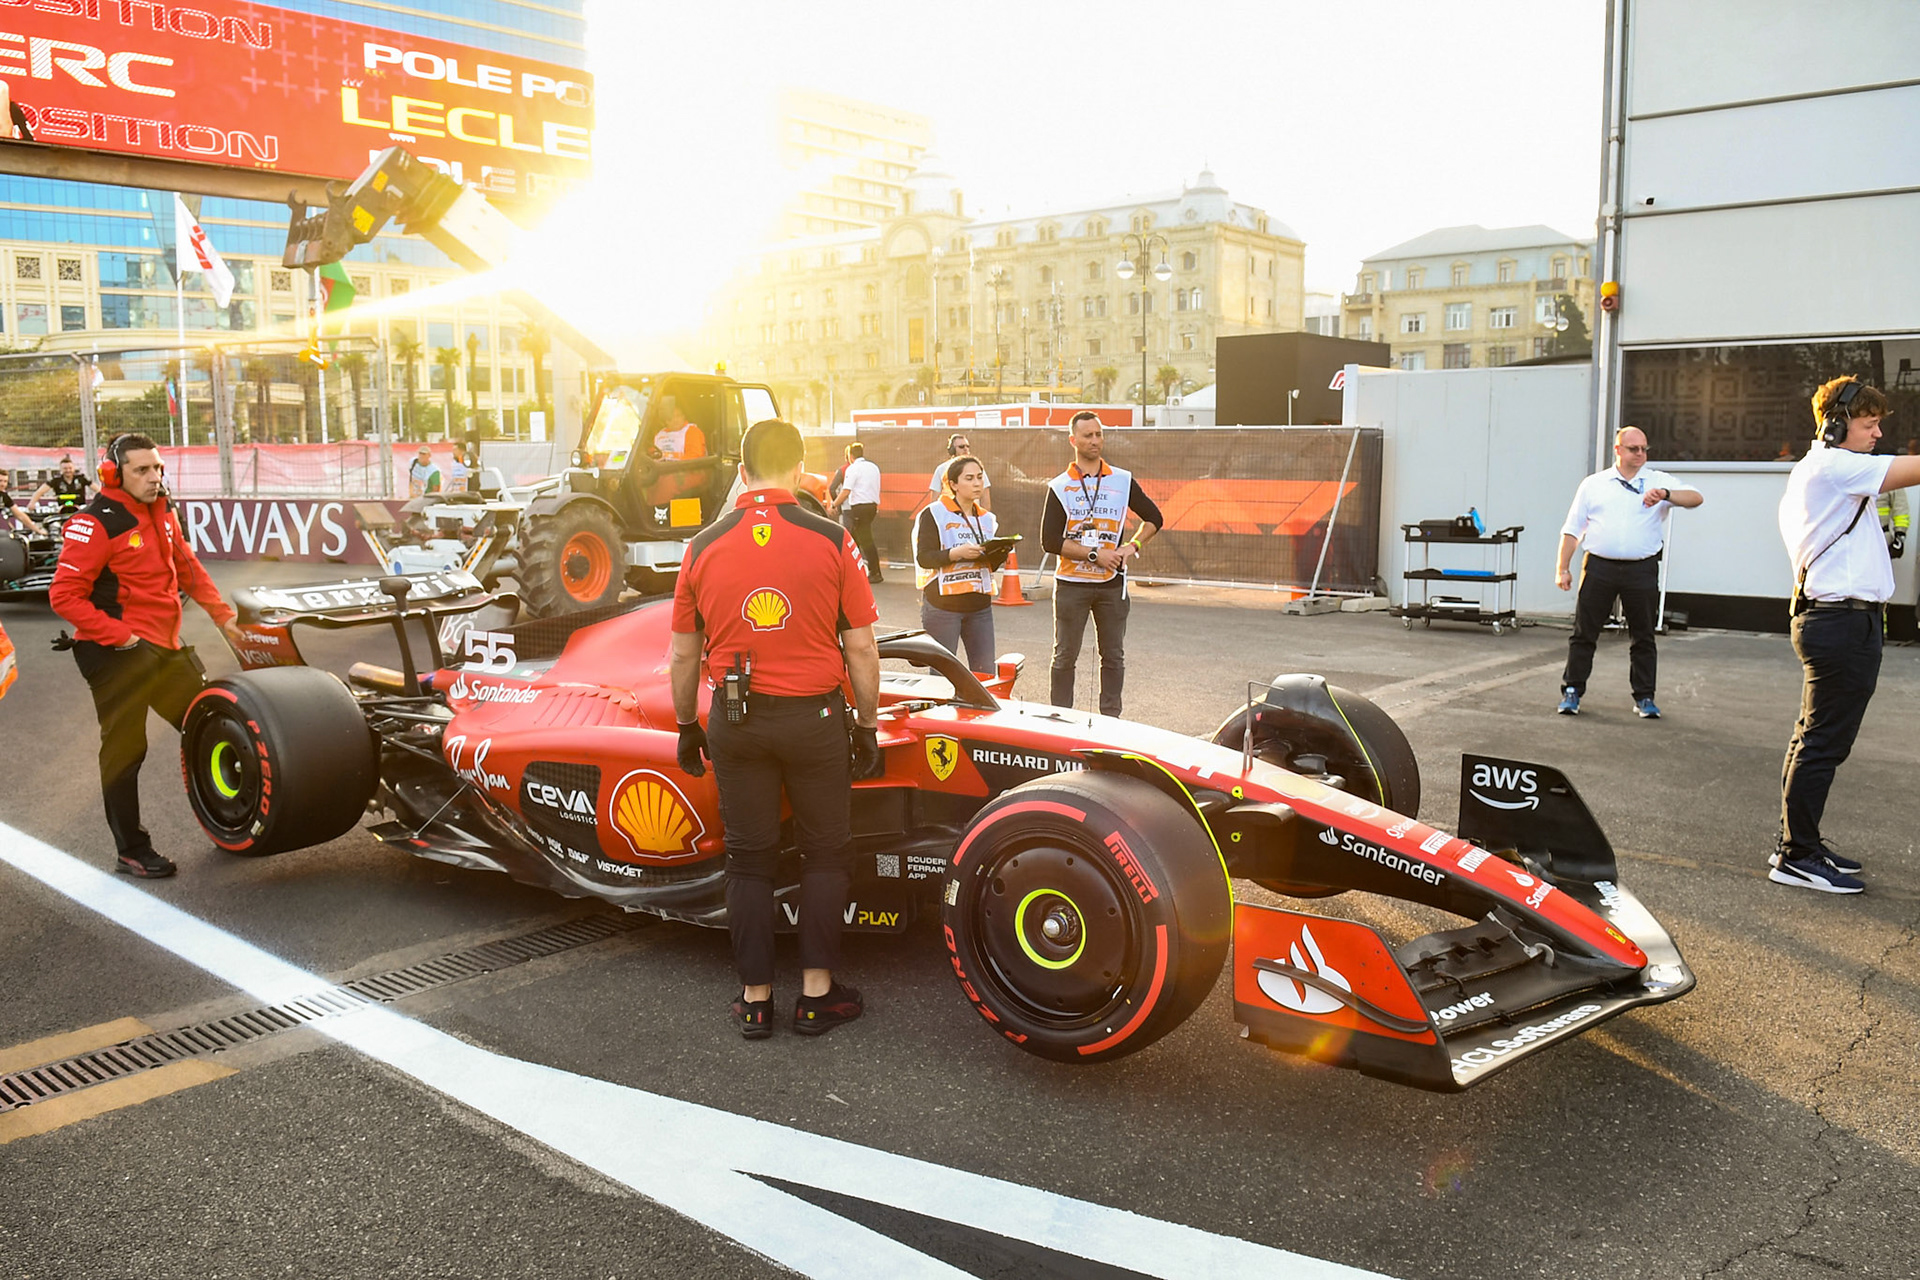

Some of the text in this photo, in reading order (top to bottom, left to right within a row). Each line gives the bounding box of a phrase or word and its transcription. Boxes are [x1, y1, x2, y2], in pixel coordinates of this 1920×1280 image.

[0, 0, 272, 50] SITION
[363, 42, 512, 94] POLE
[341, 87, 589, 161] LECLE
[176, 501, 348, 556] RWAYS
[463, 629, 517, 675] 55
[468, 680, 543, 704] Santander
[256, 740, 273, 816] ZERO
[972, 748, 1049, 771] RICHARD
[1472, 763, 1538, 794] aws
[559, 810, 599, 826] LOGISTICS
[908, 872, 927, 880] APP
[1103, 830, 1160, 905] PIRELLI
[1341, 834, 1446, 886] Santander
[858, 910, 900, 927] PLAY
